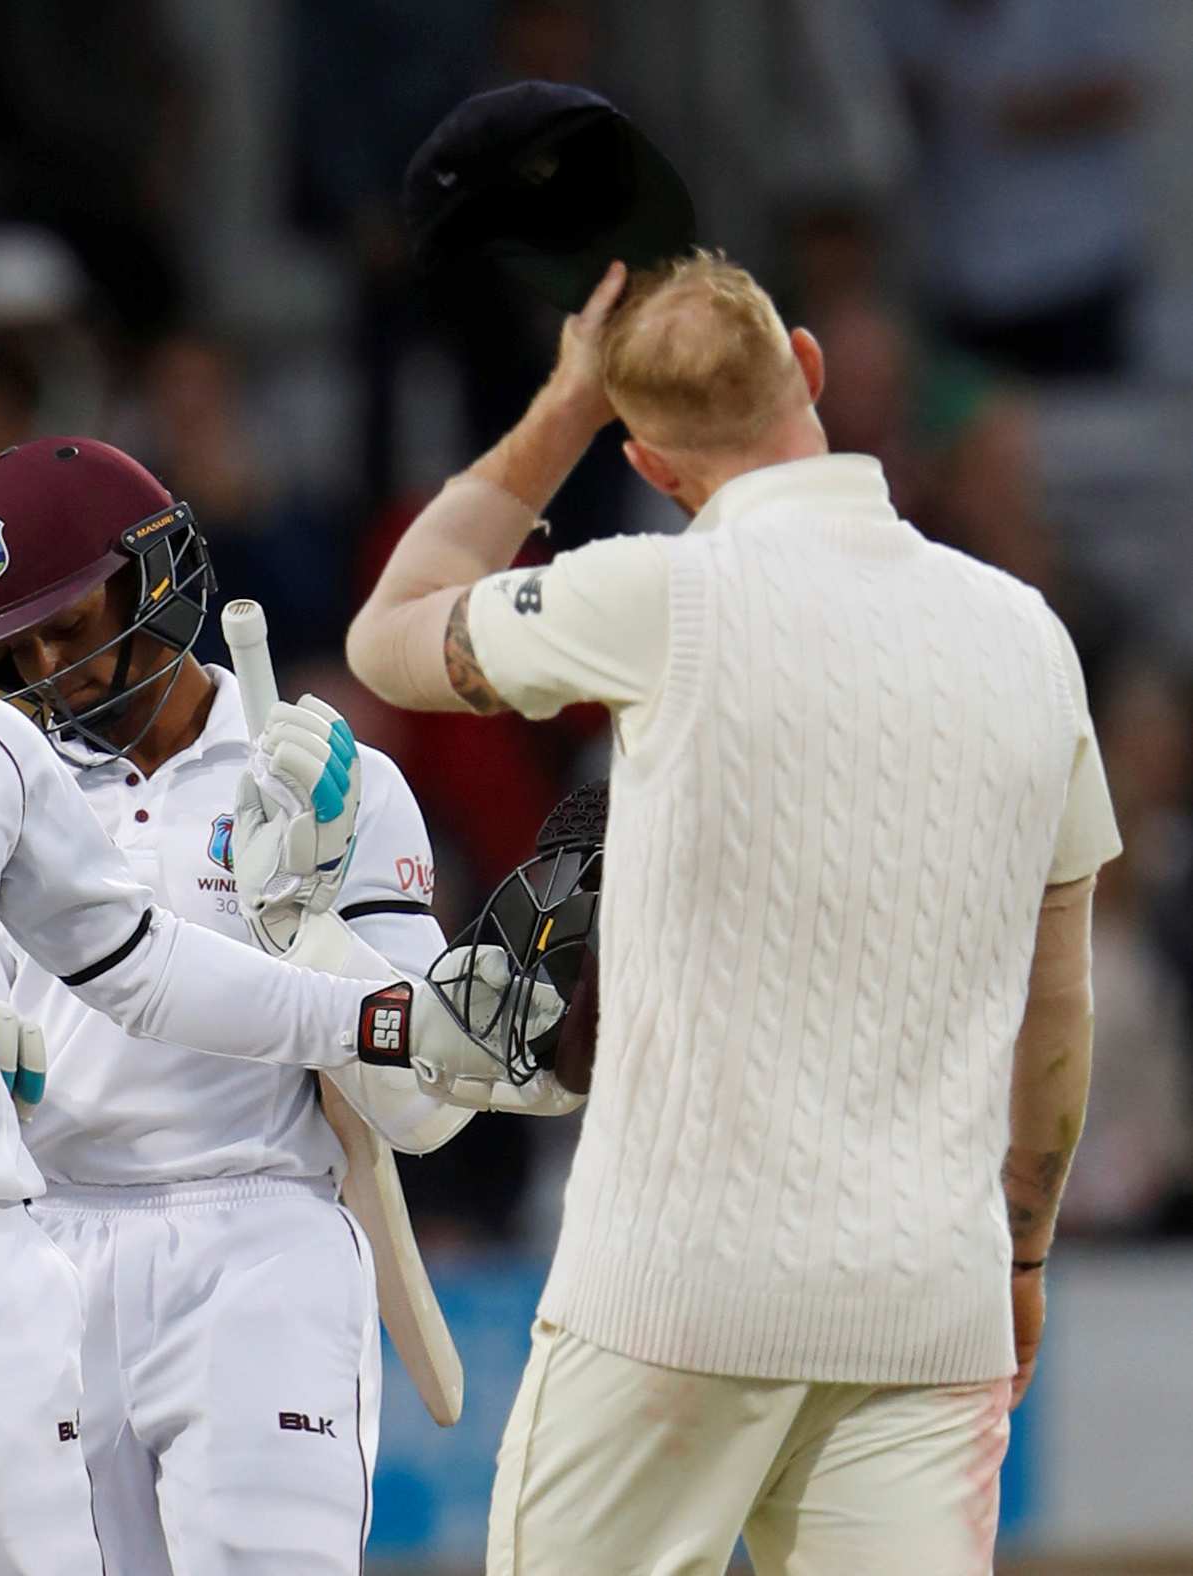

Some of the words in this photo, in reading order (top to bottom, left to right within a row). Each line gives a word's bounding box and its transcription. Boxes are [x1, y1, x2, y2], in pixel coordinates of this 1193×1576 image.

[136, 514, 174, 538] MASURI
[216, 898, 241, 915] 30
[373, 1009, 401, 1050] SS
[58, 1421, 78, 1441] BL
[278, 1412, 337, 1439] BLK
